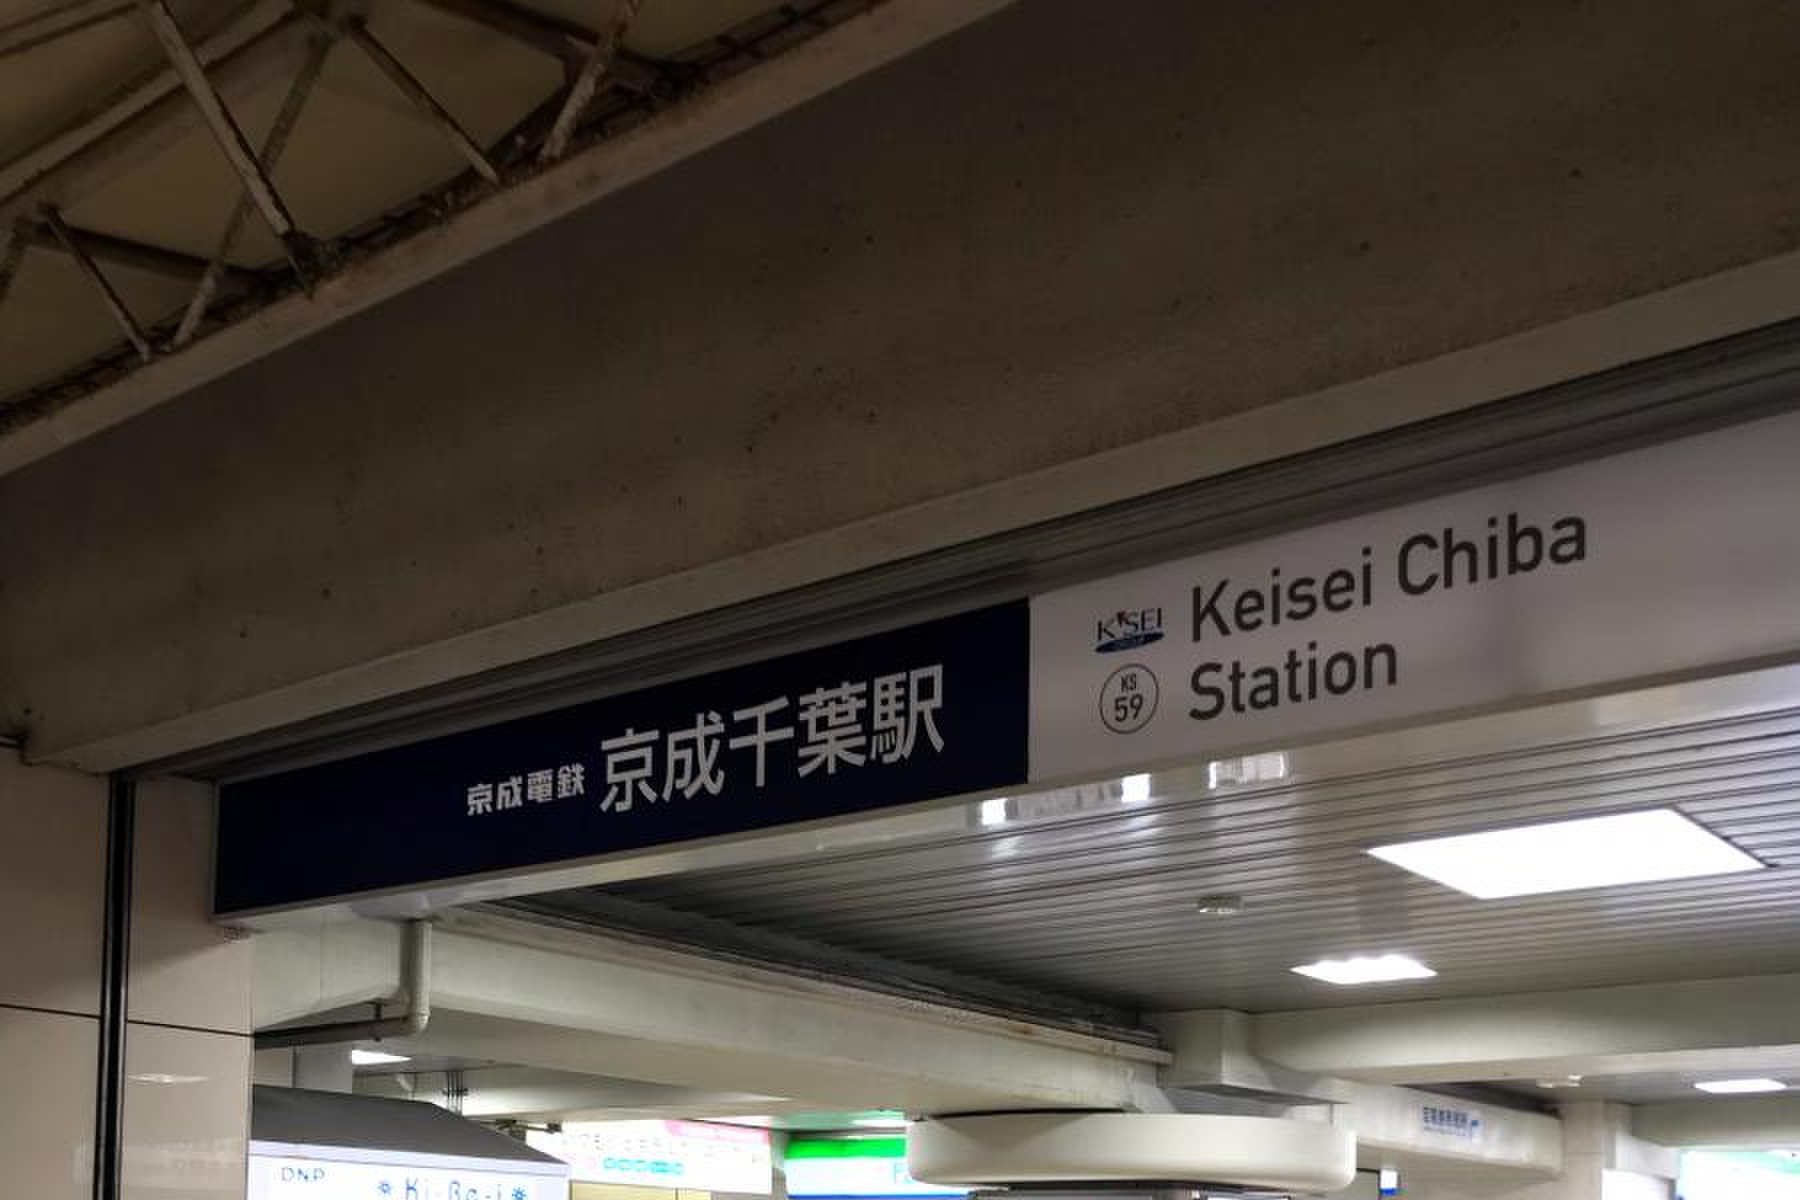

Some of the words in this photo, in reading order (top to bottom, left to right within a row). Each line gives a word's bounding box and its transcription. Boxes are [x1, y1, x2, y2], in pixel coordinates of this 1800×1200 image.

[1191, 546, 1373, 643] Keisei
[1399, 512, 1586, 596] Chiba
[1114, 693, 1143, 722] 59
[1120, 673, 1137, 692] KS
[1189, 641, 1398, 721] Station
[466, 761, 586, 817] 京成電鉄
[600, 663, 945, 814] 京成千葉駅
[281, 1165, 326, 1183] DNP
